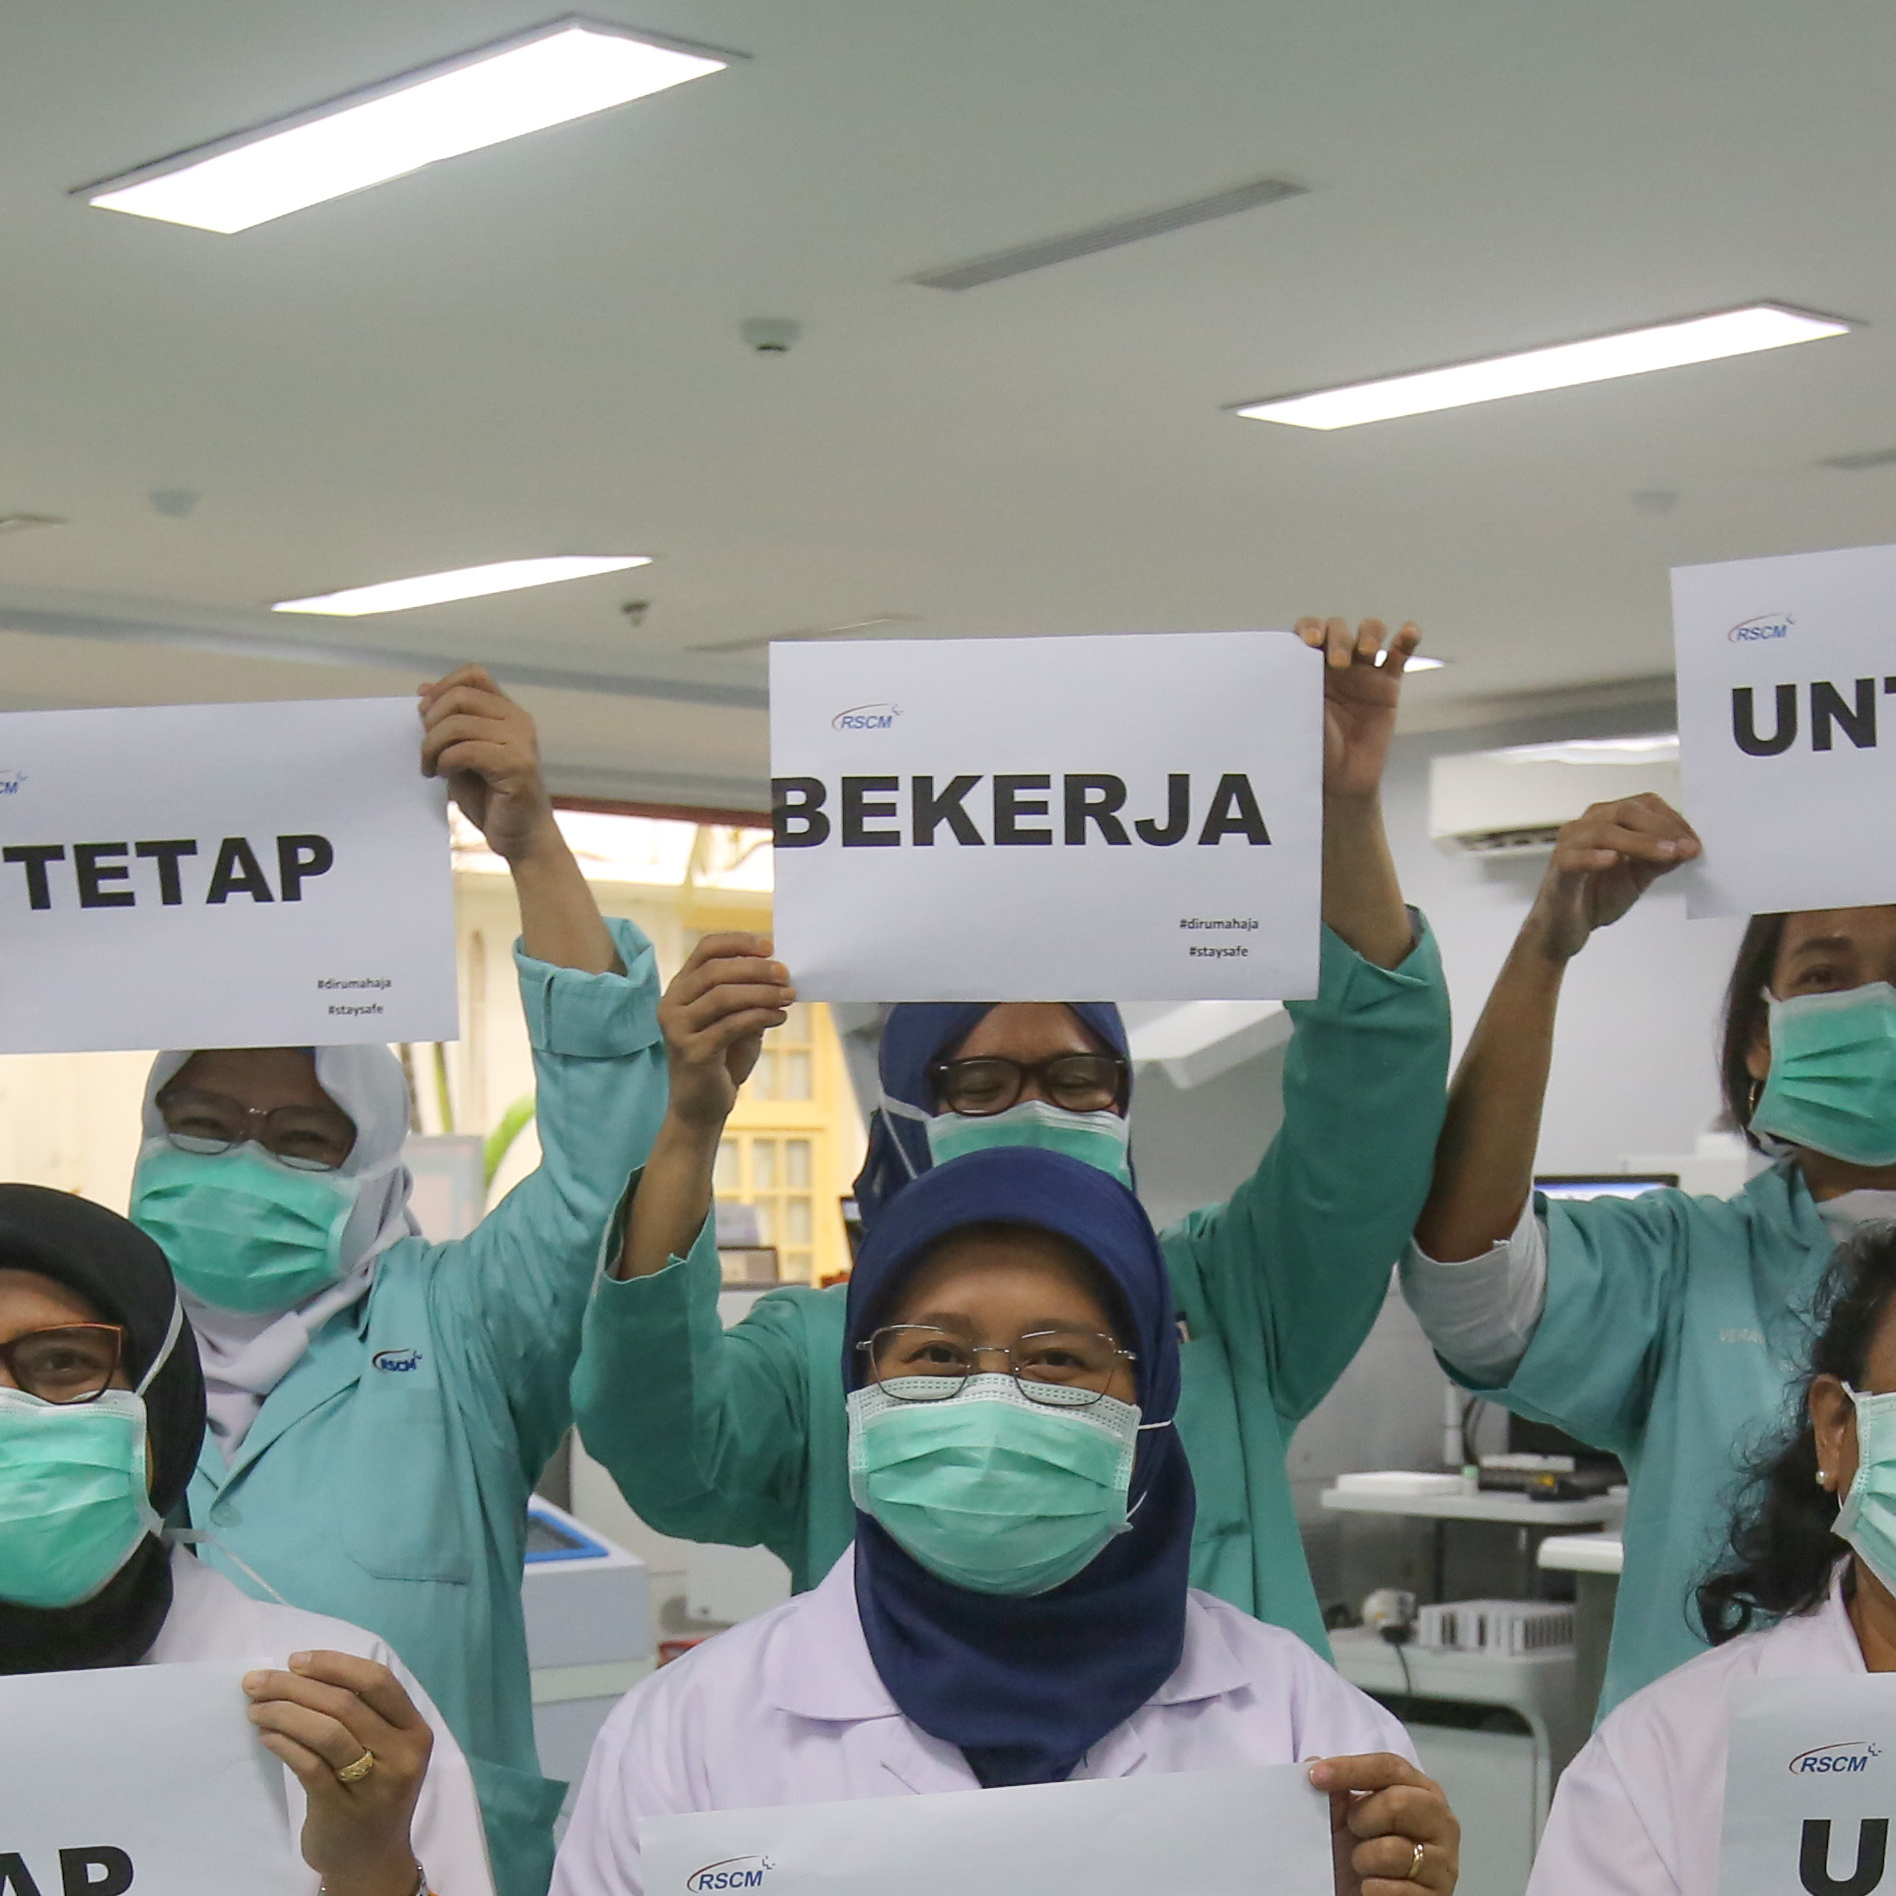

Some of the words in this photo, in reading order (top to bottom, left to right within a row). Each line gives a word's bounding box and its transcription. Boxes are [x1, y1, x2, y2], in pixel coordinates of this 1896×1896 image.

[1737, 625, 1787, 641] RSCM
[841, 714, 892, 730] RSCM
[771, 773, 1272, 847] BEKERJA
[2, 833, 334, 910] TETAP
[1180, 919, 1259, 932] #dirumahaja
[1189, 946, 1248, 959] #staysafe
[318, 978, 391, 991] #dirumahaja
[328, 1005, 383, 1016] #staysafe
[1800, 1755, 1868, 1774] RSCM
[698, 1870, 763, 1891] RSCM
